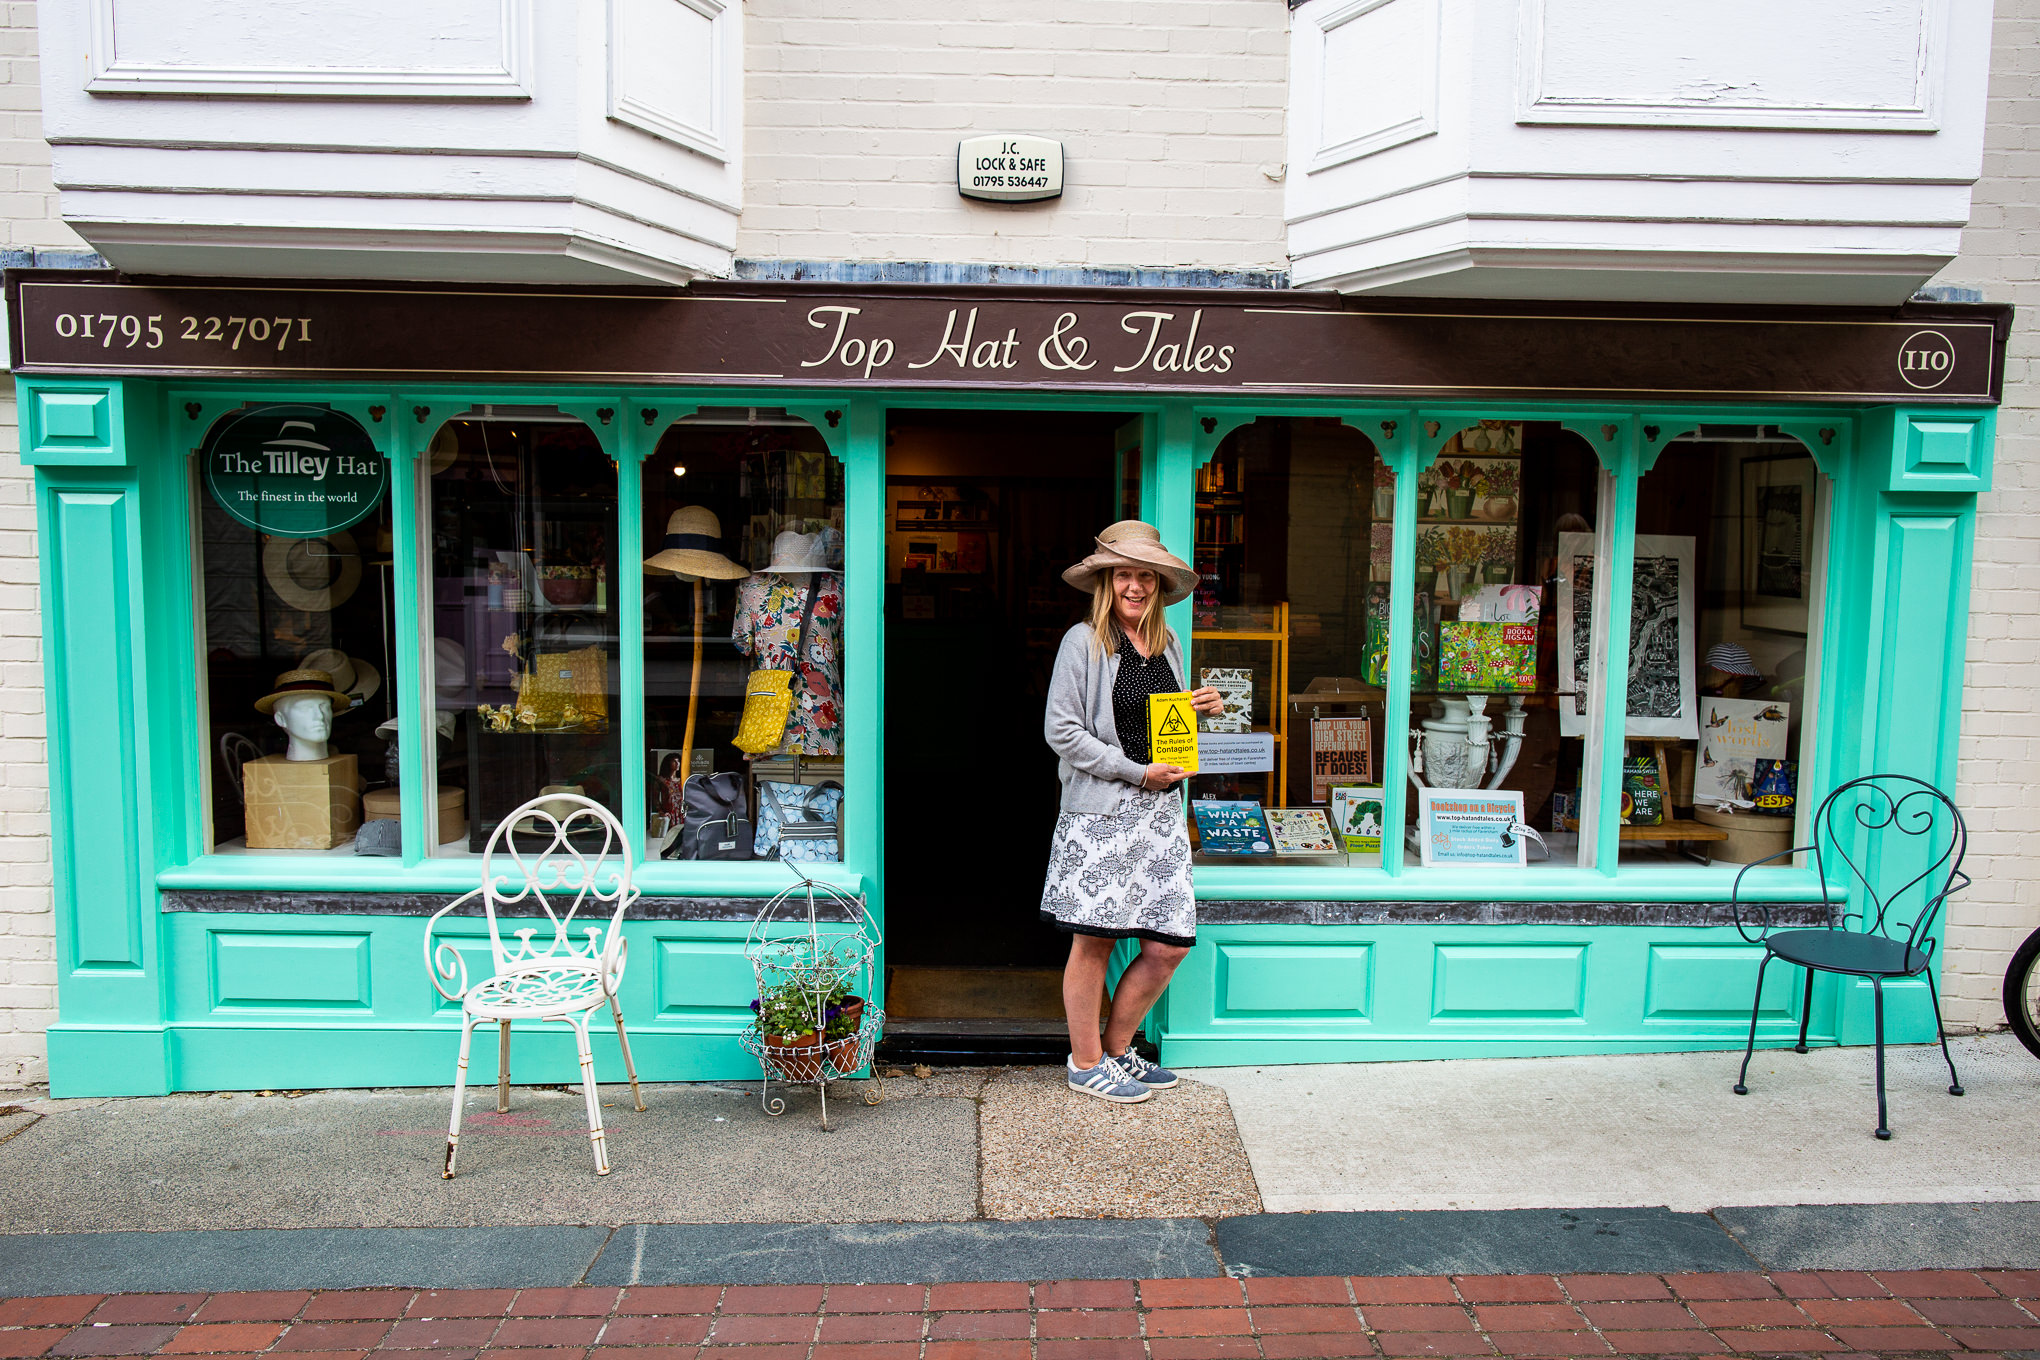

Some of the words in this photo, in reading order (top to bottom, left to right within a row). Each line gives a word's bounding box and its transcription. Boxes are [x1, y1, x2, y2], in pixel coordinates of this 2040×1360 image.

[1002, 142, 1020, 154] J.C.
[976, 158, 1006, 170] LOCK
[1009, 158, 1016, 170] &
[1020, 158, 1046, 171] SAFE
[974, 176, 1004, 187] 01795
[1008, 176, 1048, 187] 536447
[55, 313, 164, 348] 01795
[180, 315, 312, 350] 227071
[801, 305, 895, 379] Top
[907, 306, 1021, 370] Hat
[1037, 311, 1098, 370] &
[1113, 308, 1236, 373] Tales
[1903, 350, 1949, 370] 110
[219, 452, 262, 473] The
[262, 450, 330, 480] Tilley
[336, 456, 378, 475] Hat
[238, 490, 259, 501] The
[261, 490, 291, 502] finest
[294, 491, 305, 502] in
[308, 491, 324, 502] the
[327, 492, 358, 502] world
[1315, 721, 1331, 730] SHOP
[1333, 721, 1347, 729] LIKE
[1349, 721, 1366, 729] YOUR
[1728, 720, 1757, 735] lost
[1315, 730, 1334, 742] HIGH
[1337, 730, 1367, 741] STREET
[1717, 733, 1770, 748] words
[1156, 745, 1194, 753] Contagion
[1315, 741, 1346, 750] DEPENDS
[1348, 741, 1358, 750] ON
[1360, 741, 1367, 750] IT
[1316, 751, 1368, 762] BECAUSE
[1316, 763, 1327, 775] IT
[1331, 763, 1367, 775] DOES!
[1634, 790, 1657, 798] HERE
[1754, 795, 1791, 806] PESTS
[1431, 801, 1468, 812] Bookshop
[1470, 804, 1479, 812] on
[1481, 804, 1485, 812] a
[1487, 803, 1515, 814] Bicycle
[1207, 811, 1249, 819] WHAT
[1207, 829, 1260, 837] WASTE
